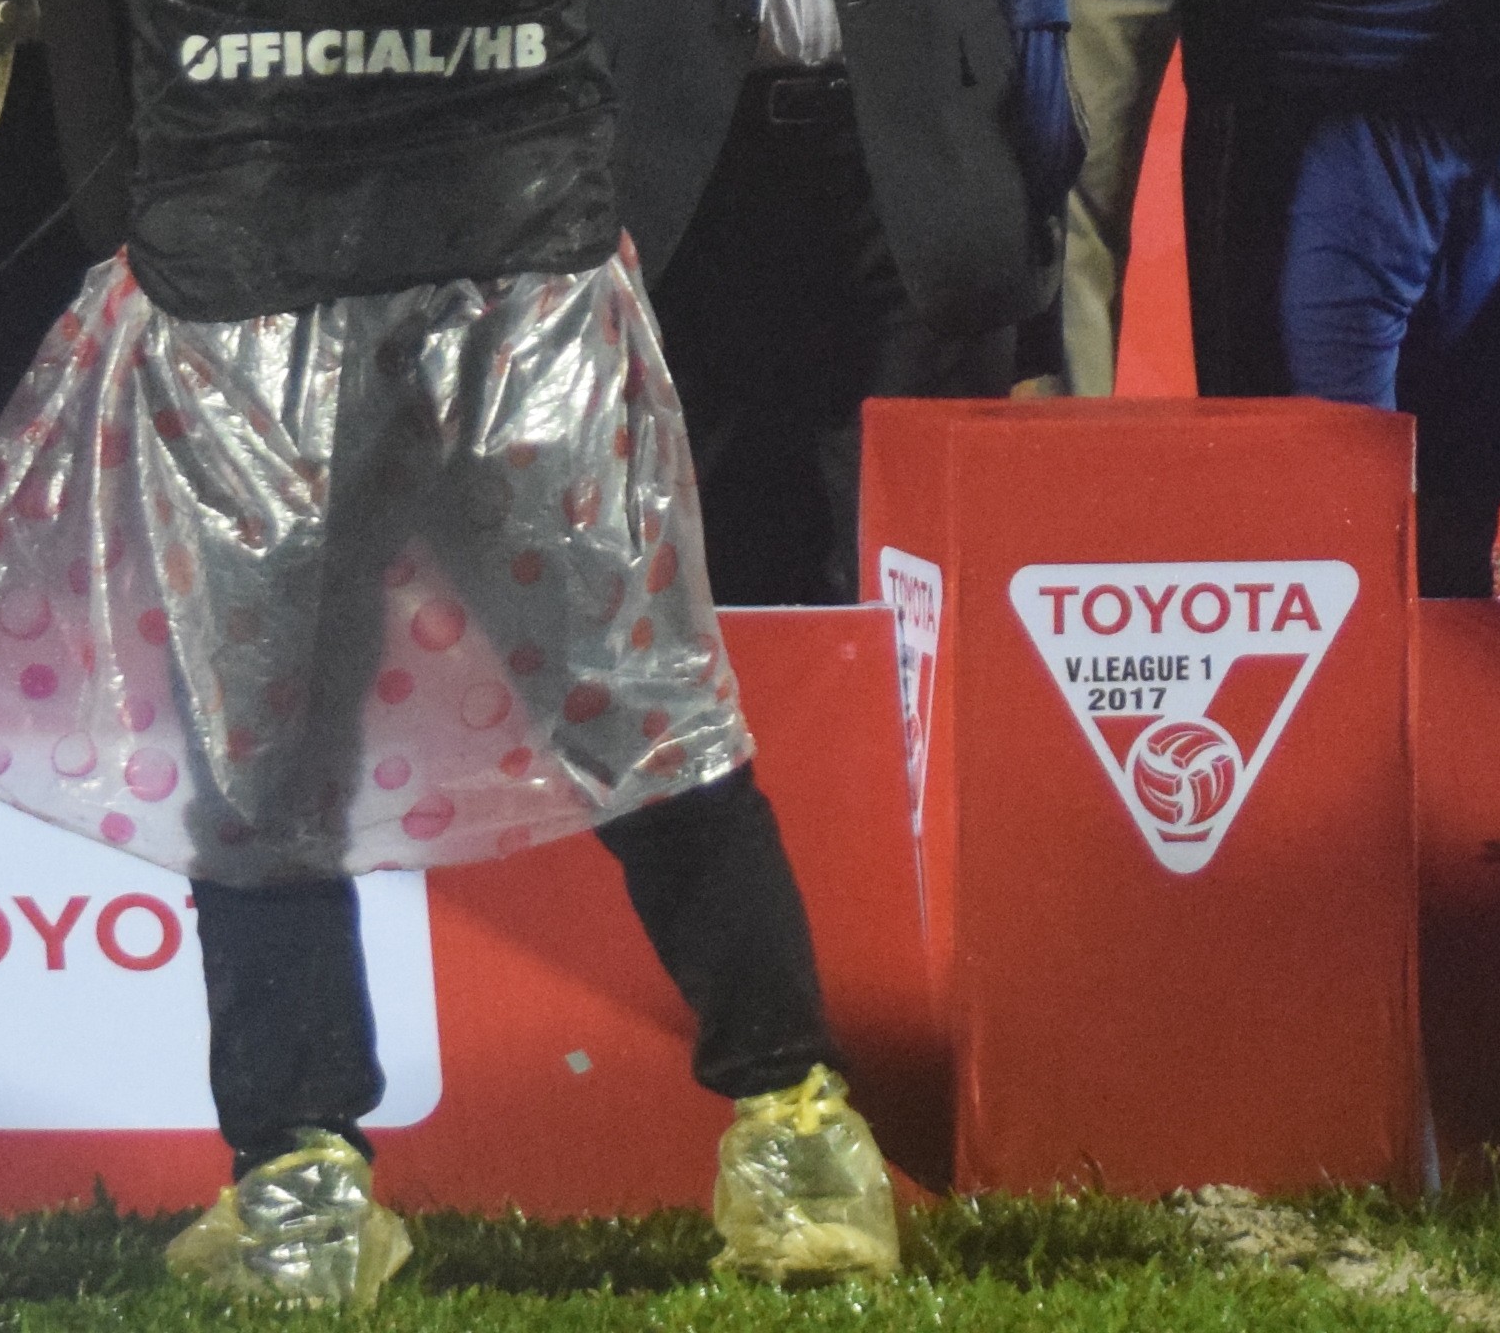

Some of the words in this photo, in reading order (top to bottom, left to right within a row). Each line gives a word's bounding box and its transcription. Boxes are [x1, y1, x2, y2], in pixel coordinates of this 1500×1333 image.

[181, 23, 548, 82] OFFICIAL/HB
[1038, 581, 1322, 636] TOYOTA
[1064, 654, 1190, 684] V.LEAGUE
[1199, 653, 1213, 681] 1
[1087, 687, 1167, 712] 2017
